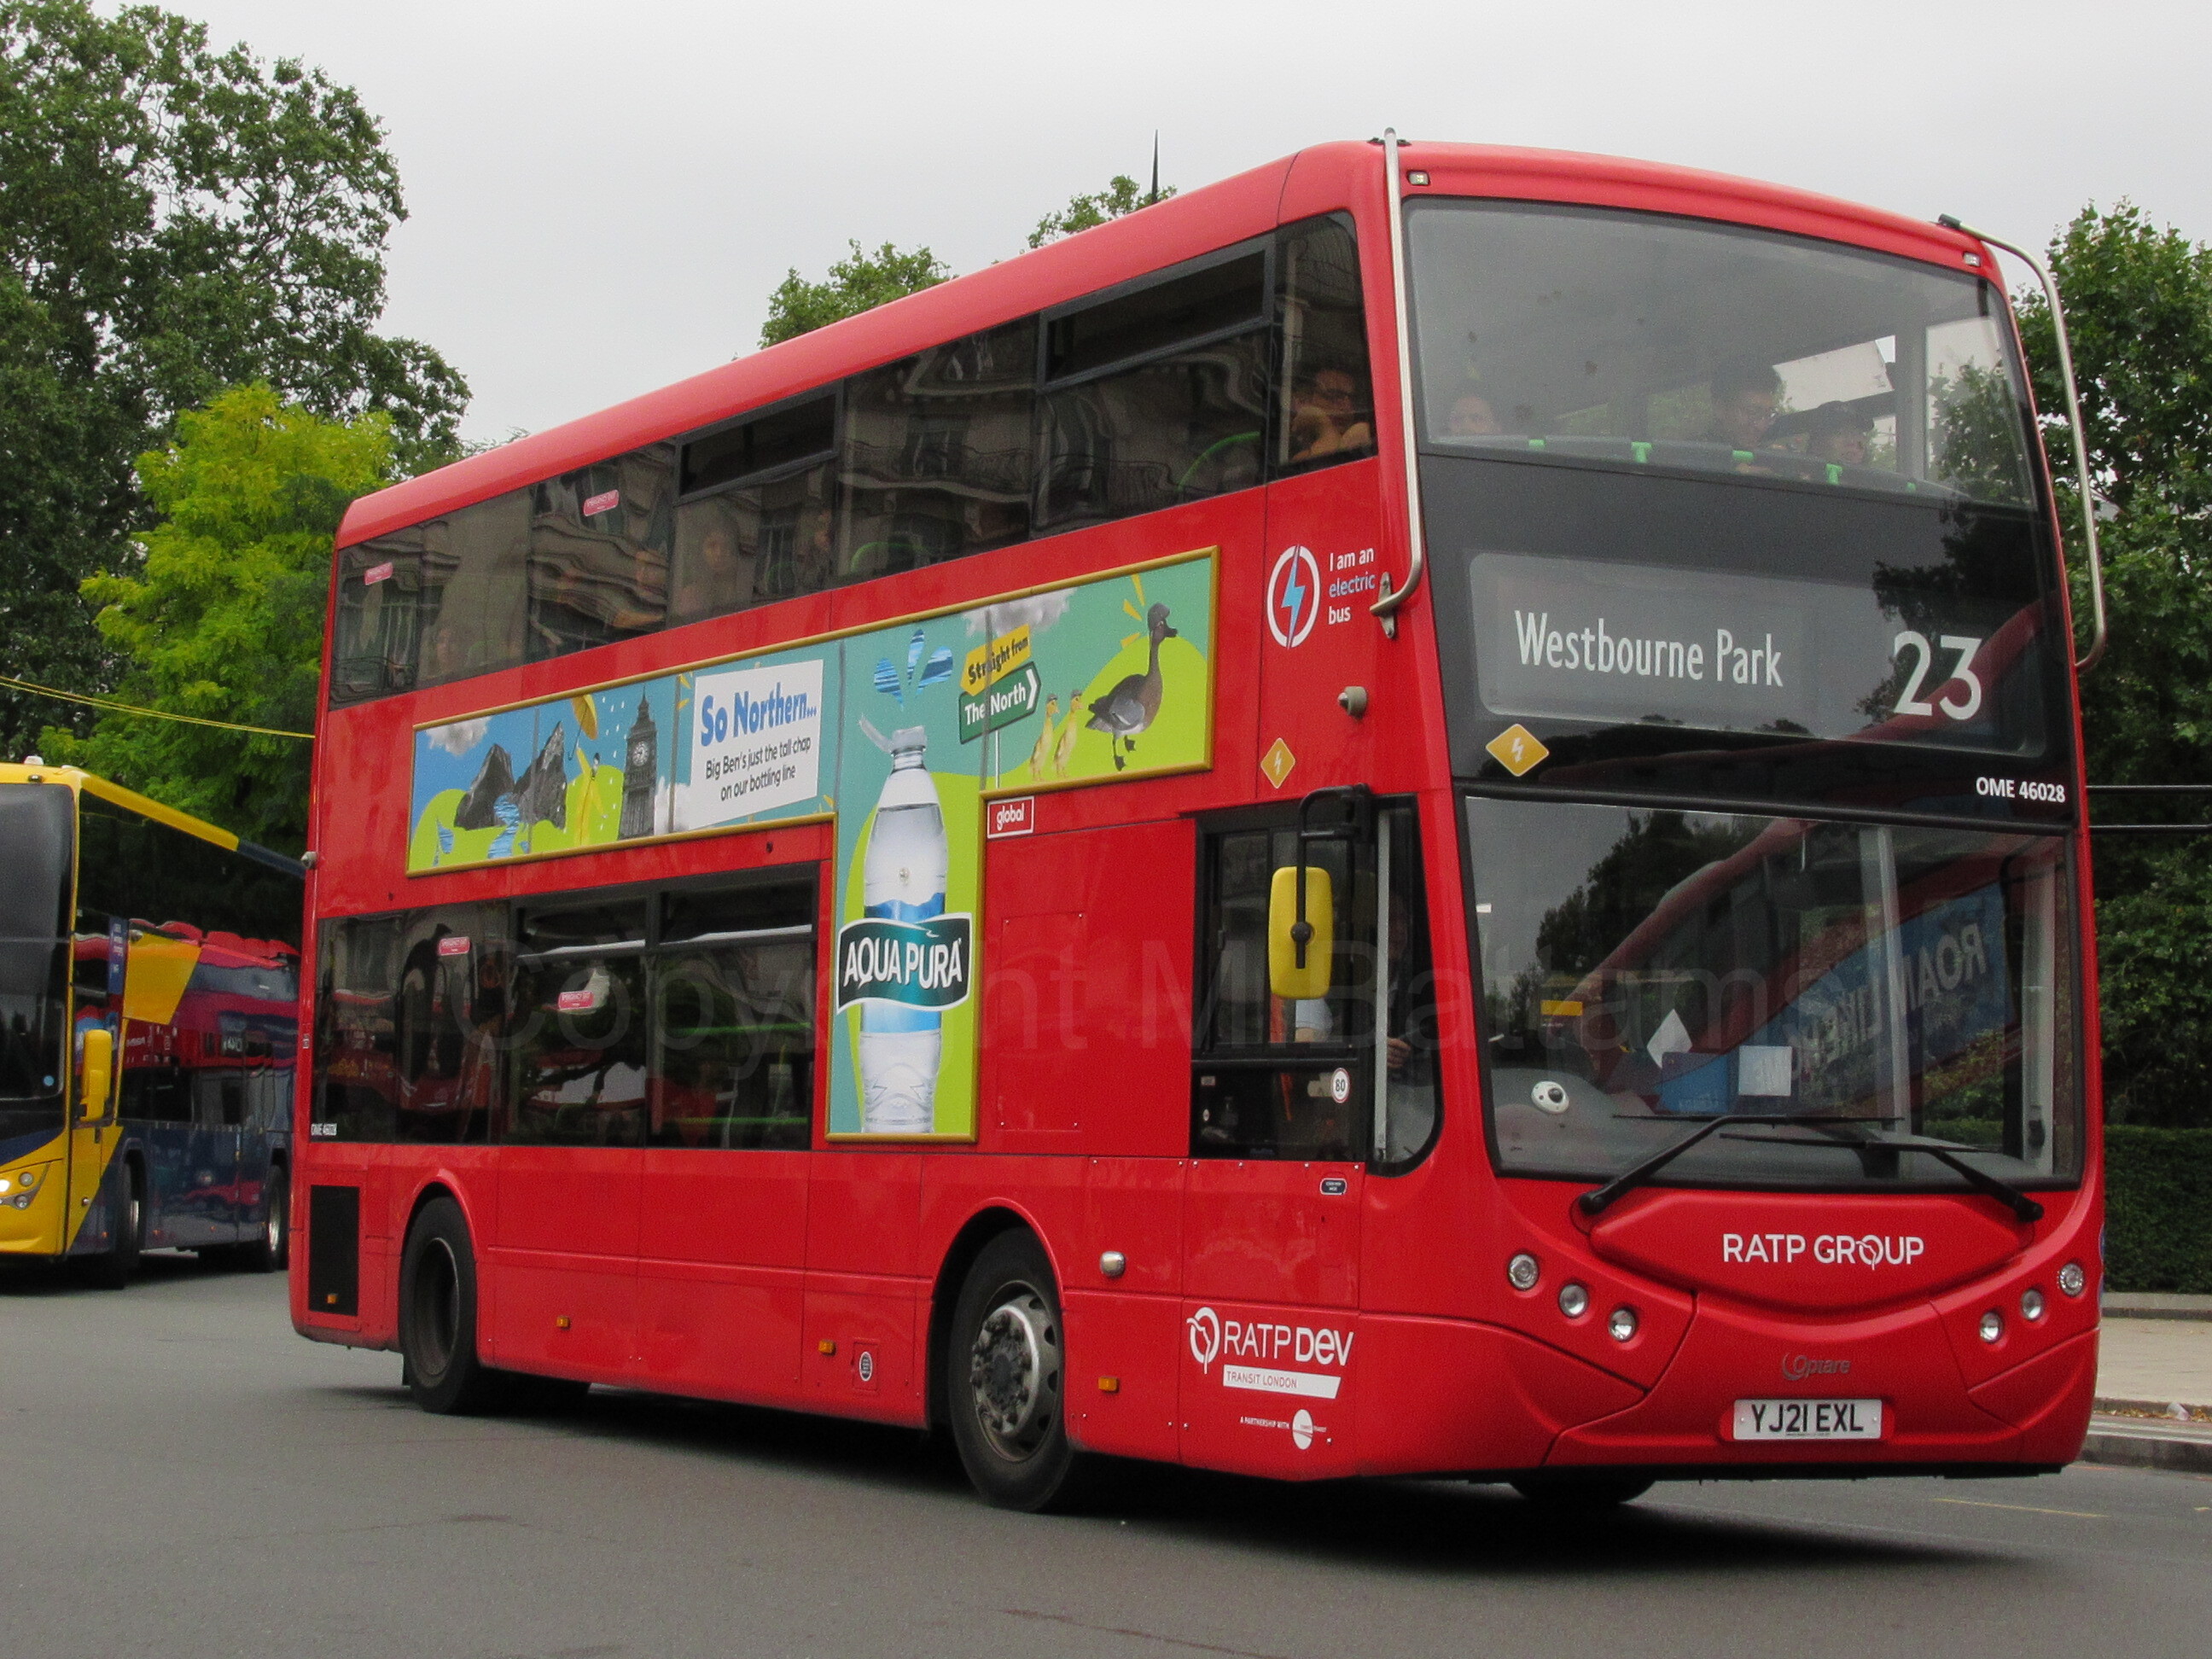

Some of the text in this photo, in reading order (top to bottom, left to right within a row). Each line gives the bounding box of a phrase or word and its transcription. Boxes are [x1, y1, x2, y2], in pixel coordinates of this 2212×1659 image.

[1330, 547, 1374, 572] I am an
[1329, 571, 1377, 597] electric
[1328, 605, 1351, 625] bus
[968, 637, 1028, 685] Straight from
[1514, 609, 1784, 687] Westbourne Park
[1893, 631, 1983, 720] 23
[701, 682, 817, 747] So Northern...
[964, 682, 1027, 725] The North
[706, 736, 811, 780] Big Ben's just the tall chap
[720, 764, 796, 801] on our bottling line
[1976, 777, 2065, 803] OME 46028
[996, 803, 1025, 831] global
[843, 937, 963, 990] AQUA PURA
[1722, 1233, 1924, 1269] RATP GROUP
[1224, 1320, 1292, 1359] RATP
[1226, 1371, 1297, 1388] TRANSIT LONDON
[1751, 1404, 1864, 1433] YJ21 EXL
